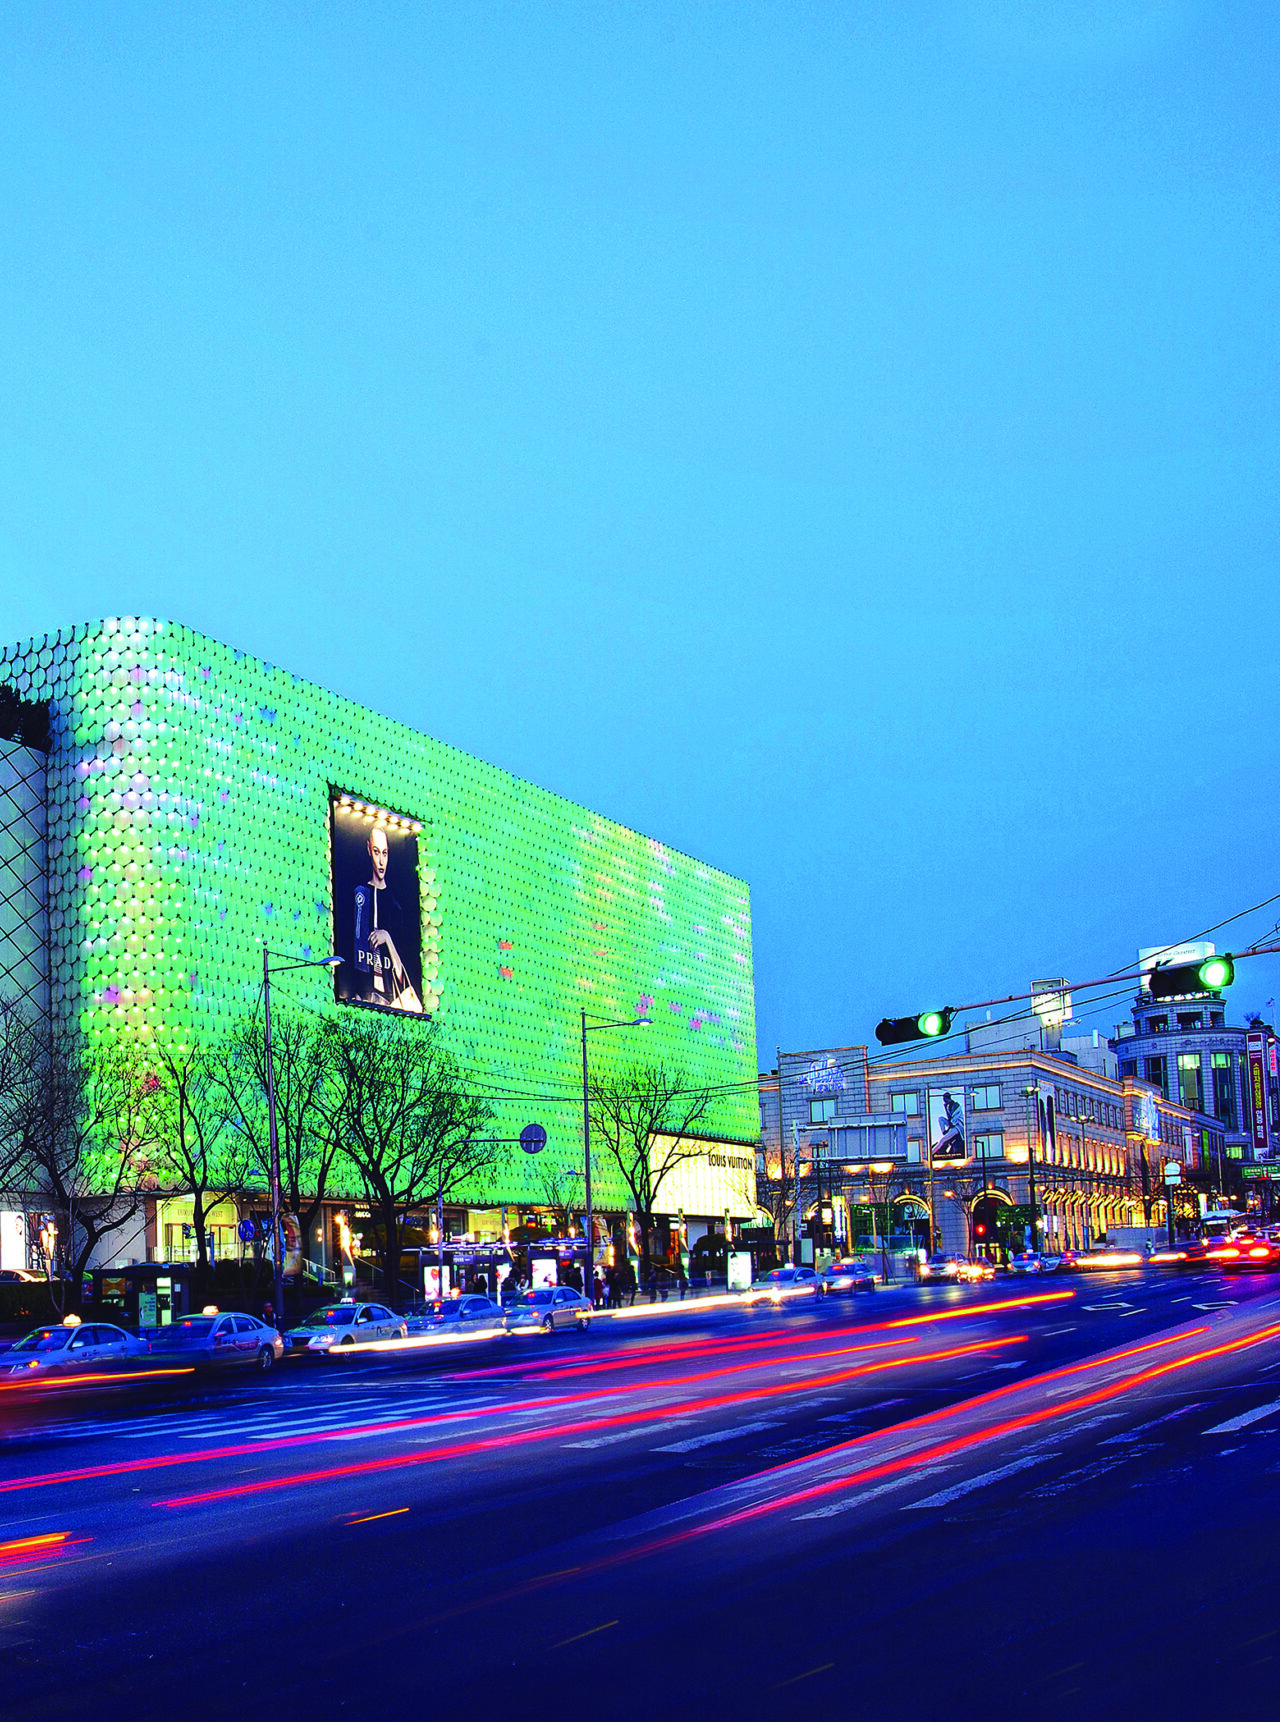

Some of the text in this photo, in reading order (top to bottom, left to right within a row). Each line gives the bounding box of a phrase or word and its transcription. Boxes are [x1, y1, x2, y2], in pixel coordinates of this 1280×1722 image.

[357, 949, 396, 970] PRAD
[708, 1153, 753, 1171] LOUIS VUITTON
